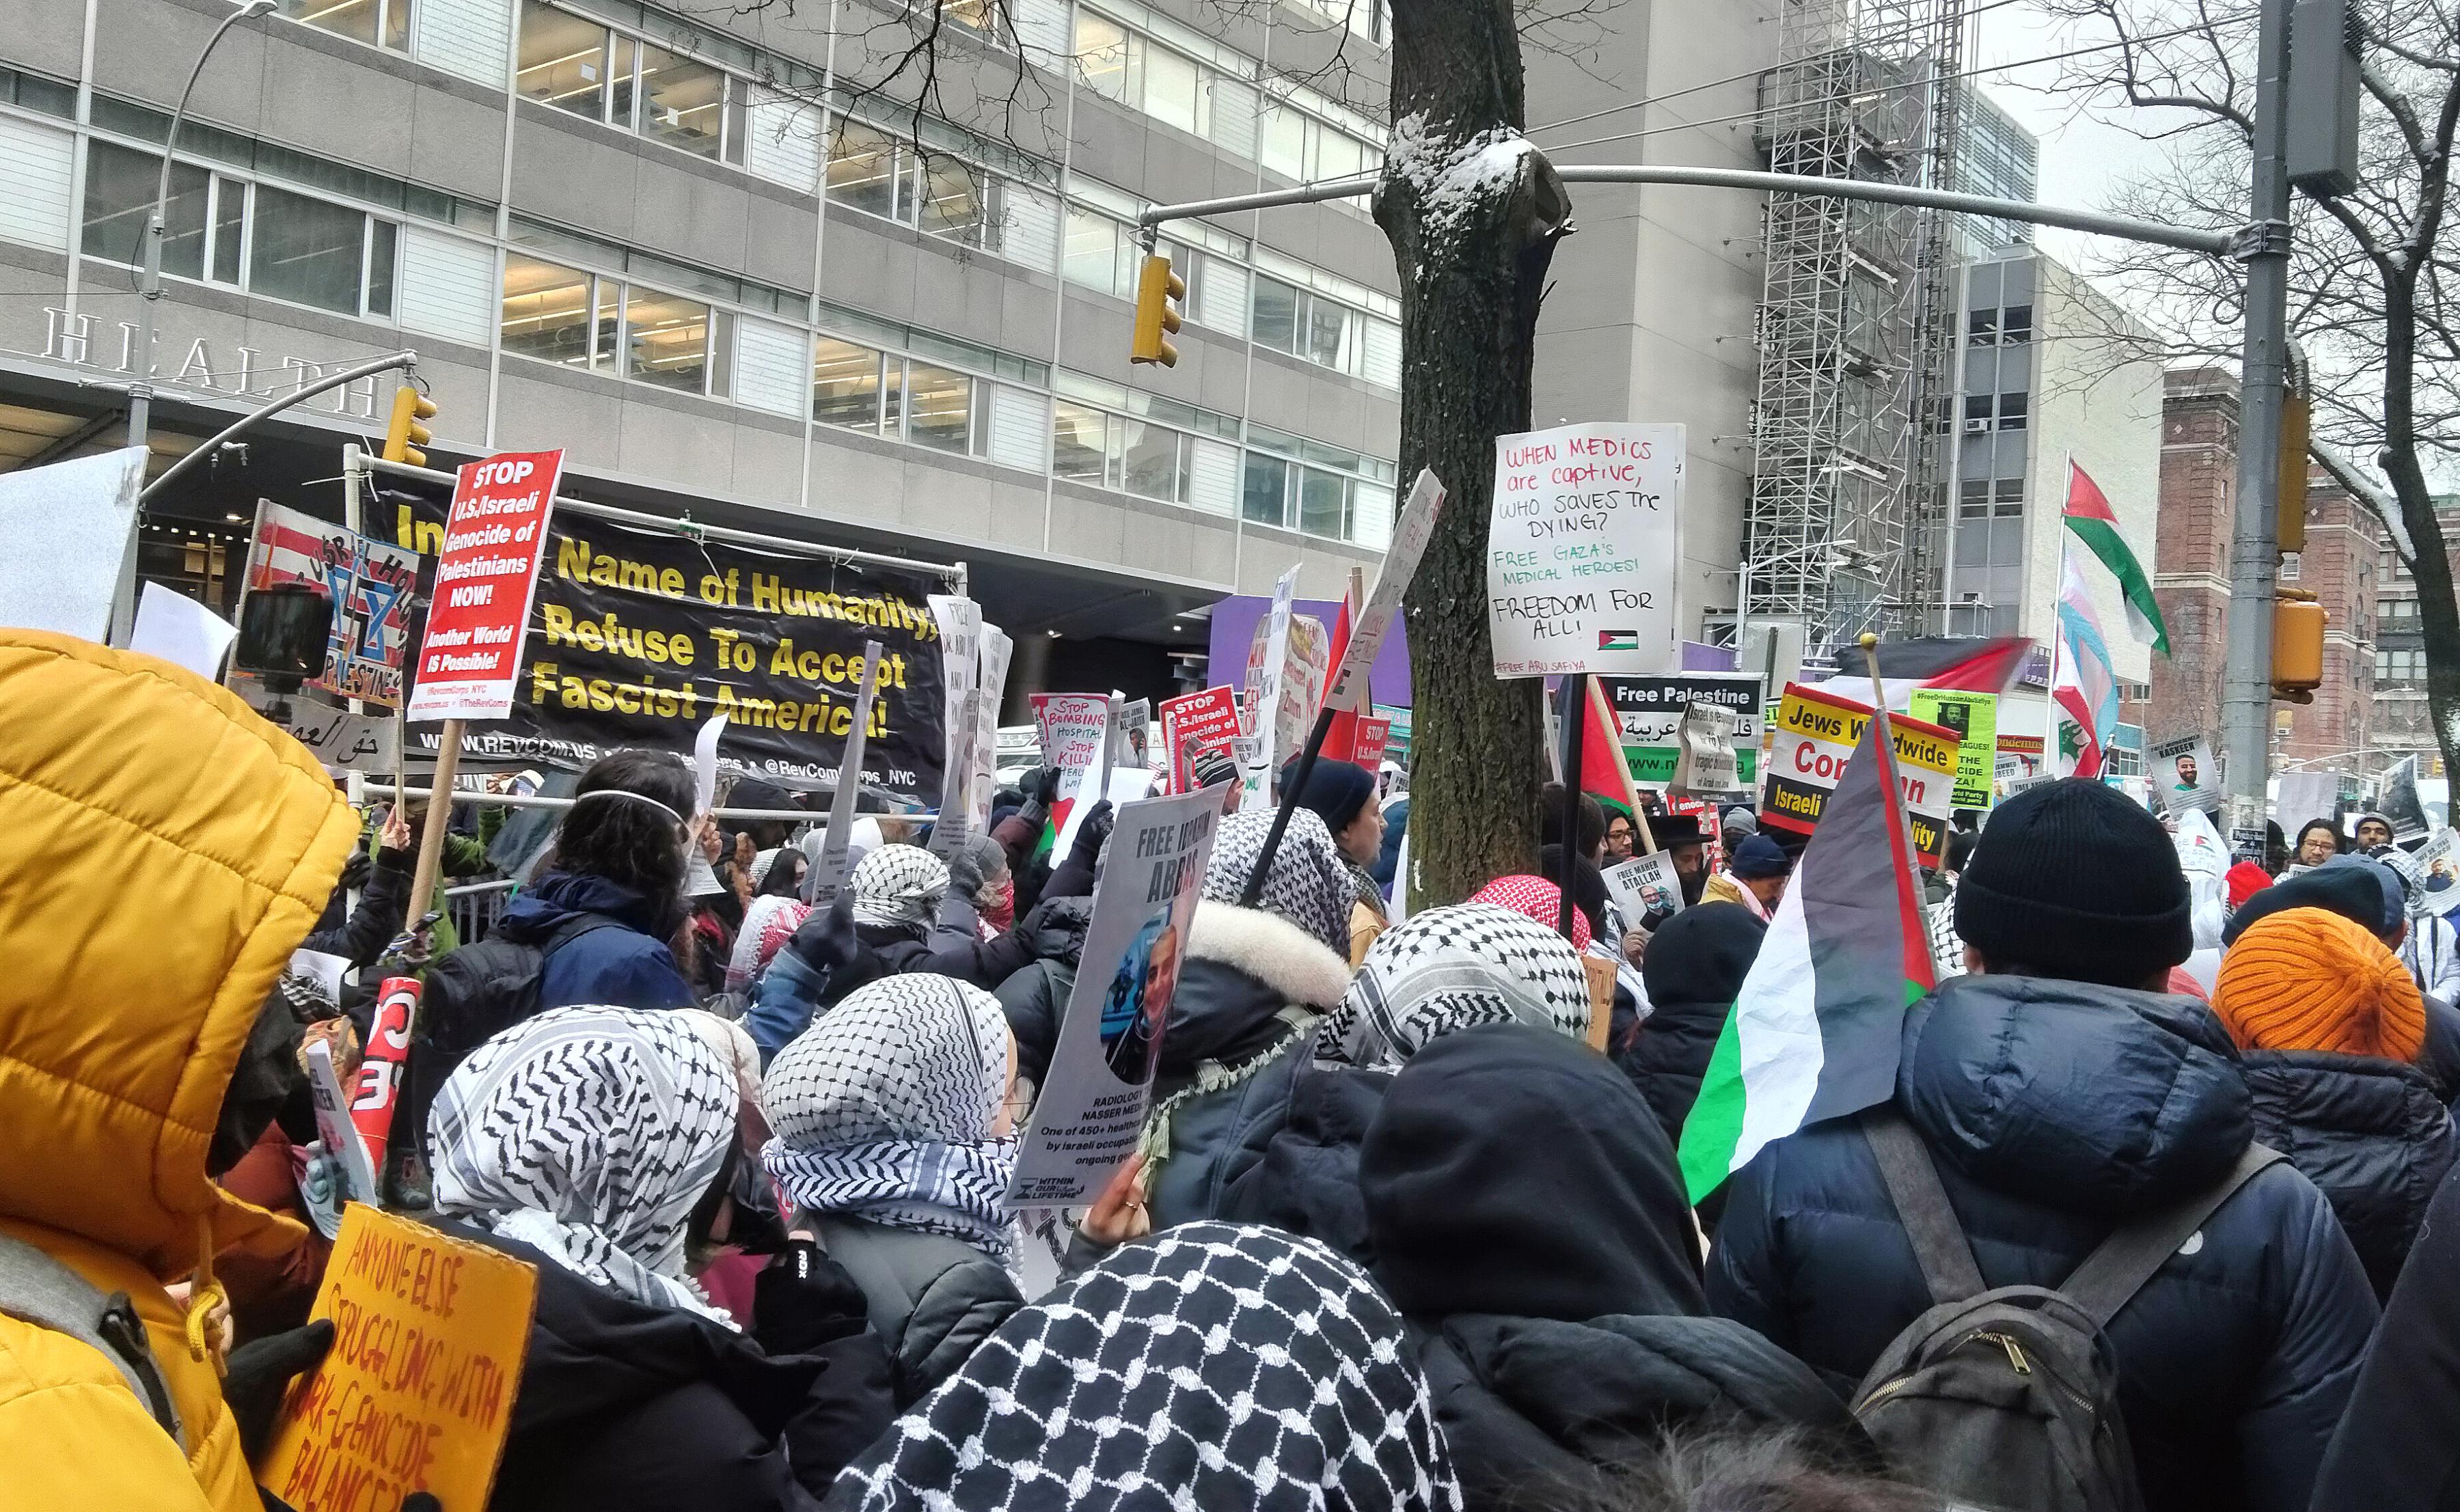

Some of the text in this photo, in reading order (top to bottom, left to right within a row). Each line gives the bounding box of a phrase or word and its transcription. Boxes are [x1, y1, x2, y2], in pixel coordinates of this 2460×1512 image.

[41, 307, 384, 421] HEALTH
[1506, 445, 1557, 468] WHEN
[474, 461, 534, 489] STOP
[1507, 463, 1642, 491] are captive,
[454, 491, 540, 522] U.S./Israeli
[1500, 499, 1540, 519] WHO
[397, 504, 445, 557] In
[1527, 512, 1608, 538] DYING?
[446, 521, 536, 553] Genocide of
[439, 556, 528, 584] Palestinians
[1493, 550, 1539, 568] FREE
[556, 536, 685, 599] Name
[700, 571, 740, 608] of
[1503, 559, 1639, 587] MEDICAL HEROES!
[450, 585, 493, 607] NOW!
[1492, 589, 1654, 622] FREEDOM FOR
[426, 624, 514, 649] Another World
[1533, 619, 1581, 640] ALL!
[543, 603, 907, 696] Refuse To Accept
[426, 651, 500, 673] IS Possible!
[1528, 661, 1548, 672] ABU
[532, 660, 698, 721] Fascist
[1616, 686, 1750, 704] Free Palestine
[1054, 700, 1089, 713] STOP
[1175, 695, 1216, 715] STOP
[1048, 713, 1105, 726] BOMBING
[1177, 706, 1229, 728] .S./Israeli
[1179, 723, 1222, 742] enocide
[1224, 718, 1235, 729] of
[1365, 725, 1384, 741] STOP
[1788, 704, 1843, 737] Jews
[1850, 718, 1948, 767] Wdwide
[336, 729, 379, 765] حق
[420, 732, 597, 760] WW.REVCOM.US
[1066, 741, 1095, 752] STOP
[1959, 741, 1990, 751] EAGUES!
[1695, 753, 1714, 773] tragic
[1957, 766, 1984, 776] CIDE
[1958, 755, 1981, 765] THE
[766, 758, 917, 786] @RevComrps_NYC
[1795, 741, 1926, 804] Conn
[1955, 777, 1976, 788] ZA!
[1775, 784, 1822, 816] Israeli
[1136, 825, 1175, 859] FREE
[1147, 848, 1198, 903] ABBAS
[1616, 860, 1659, 880] FREE MAHER
[1622, 869, 1662, 891] ATALLAH
[1093, 1090, 1143, 1108] RADIOLOGY
[1082, 1109, 1121, 1121] NASSER
[1041, 1119, 1141, 1136] One of 450+ healthca
[1046, 1141, 1061, 1152] by
[1096, 1134, 1138, 1149] occupatio
[1076, 1153, 1116, 1166] ongoing
[1039, 1177, 1075, 1185] WITHIN
[1031, 1191, 1077, 1200] LIFETIME
[343, 1223, 464, 1319] ANYONE ELSE
[798, 1249, 808, 1280] RDX
[439, 1343, 506, 1433] WITH
[288, 1372, 443, 1489] ORK-GENOCIDE
